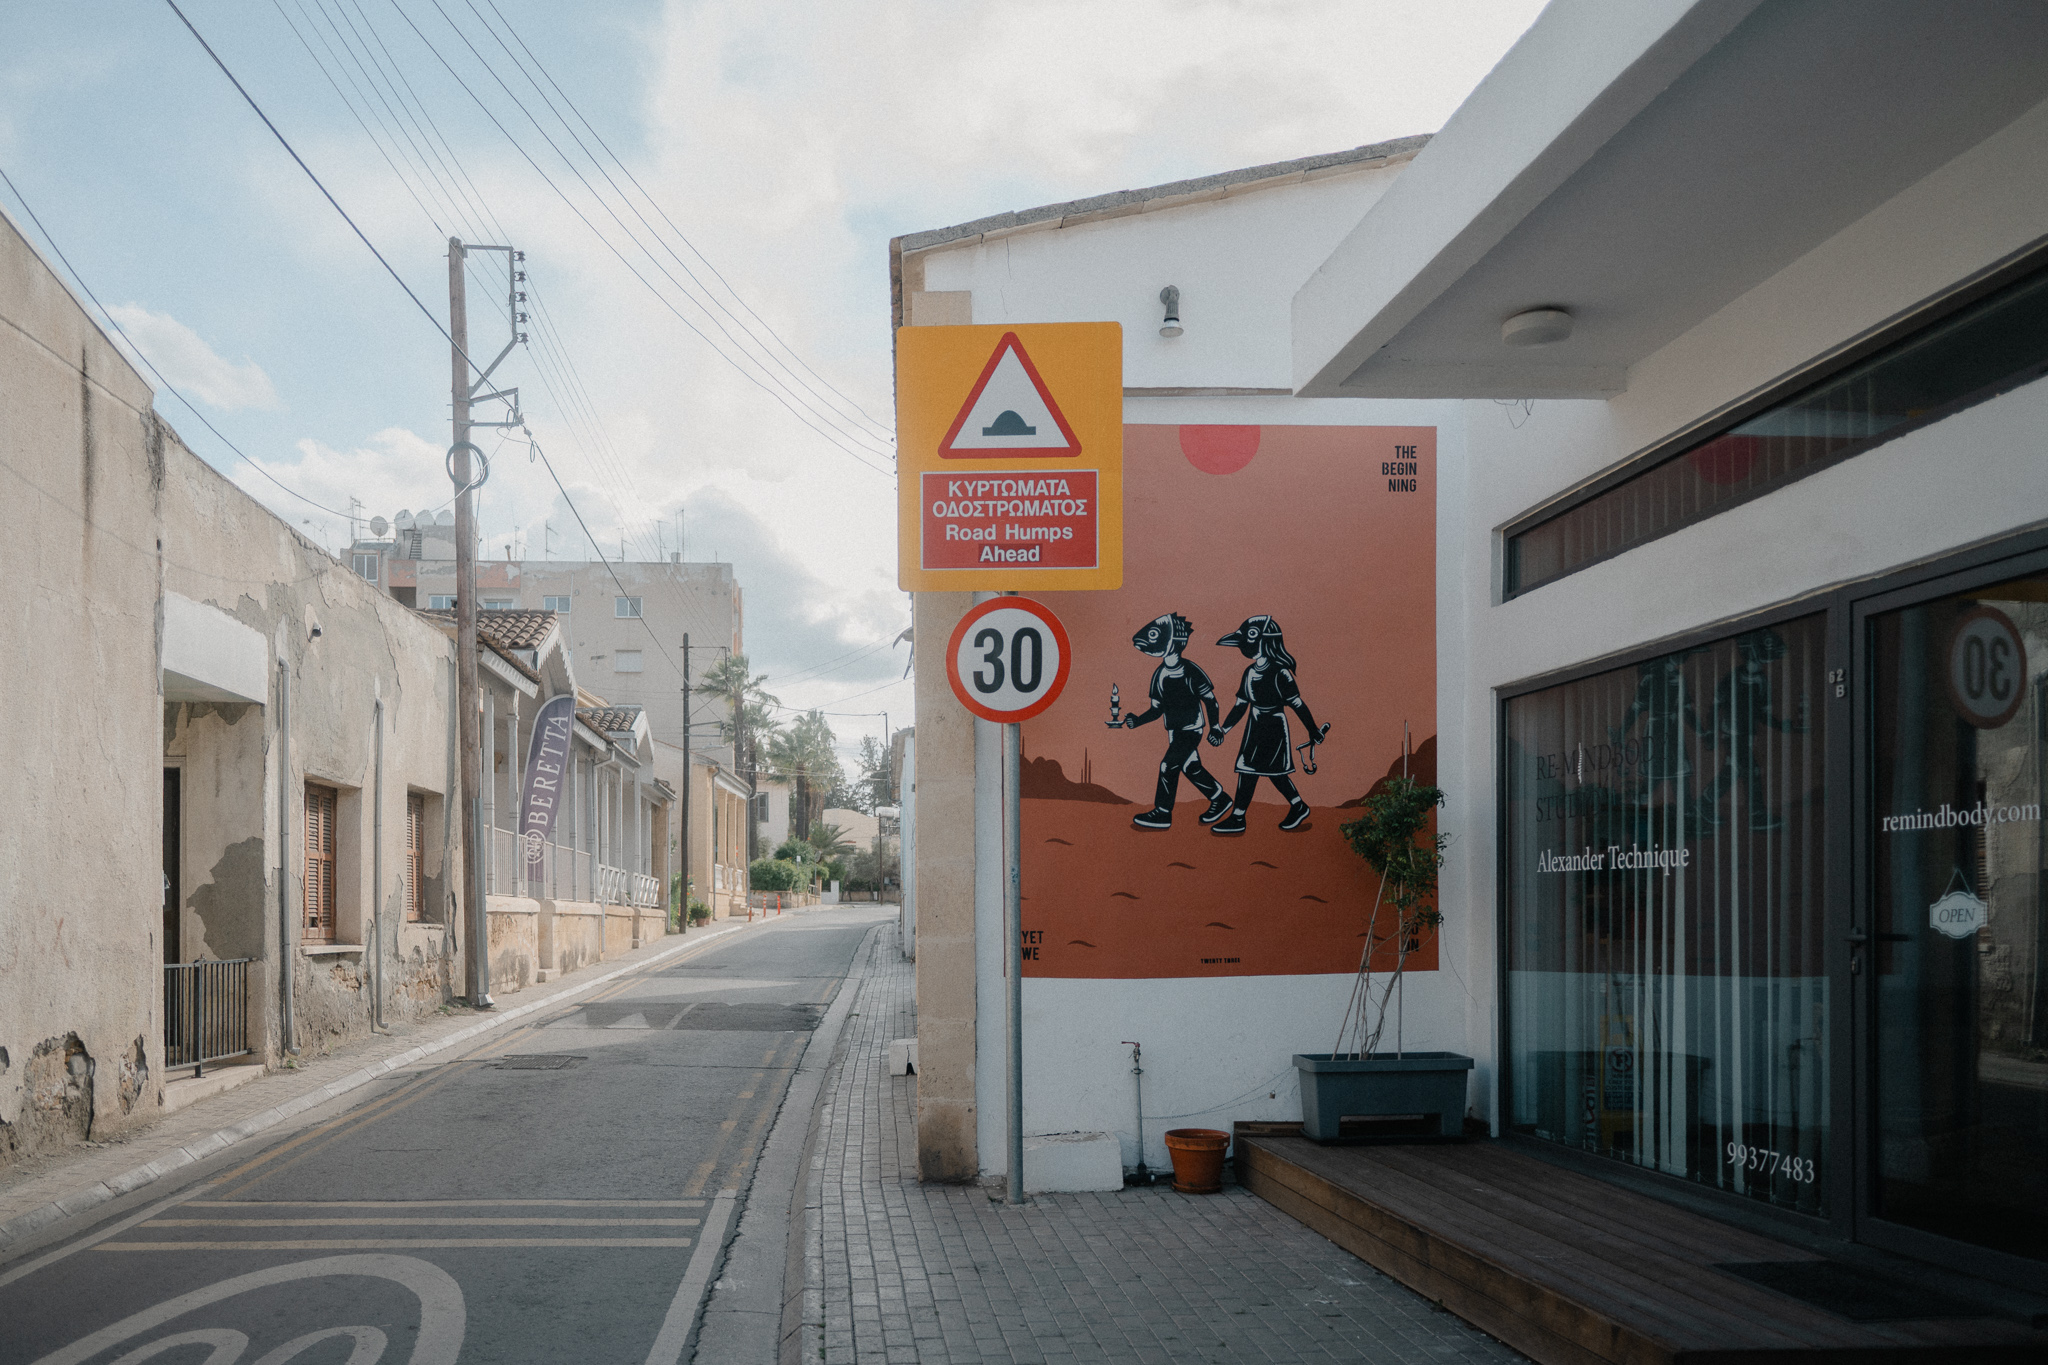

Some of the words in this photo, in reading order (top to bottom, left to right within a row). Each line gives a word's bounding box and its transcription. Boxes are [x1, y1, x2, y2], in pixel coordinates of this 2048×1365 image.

[1394, 445, 1417, 459] THE
[1382, 462, 1417, 476] BEGIN
[948, 479, 1071, 497] ΚΥΡΤΩΜΑΤΑ
[1388, 478, 1417, 492] NING
[932, 499, 1088, 518] ΟΔΟΣΤΡΩΜΑΤΟΣ
[945, 523, 997, 541] Road
[1005, 523, 1074, 543] Humps
[979, 545, 1040, 562] Ahead
[972, 626, 1043, 694] 30
[1829, 668, 1845, 684] 62
[1836, 684, 1845, 698] B
[528, 715, 569, 827] BERETTA
[1882, 801, 2042, 832] remindbody.com
[1537, 846, 1605, 873] Alexander
[1607, 843, 1690, 876] Technique
[1938, 907, 1976, 924] OPEN
[1021, 930, 1044, 944] YET
[1021, 947, 1040, 961] WE
[1727, 1141, 1815, 1184] 99377483
